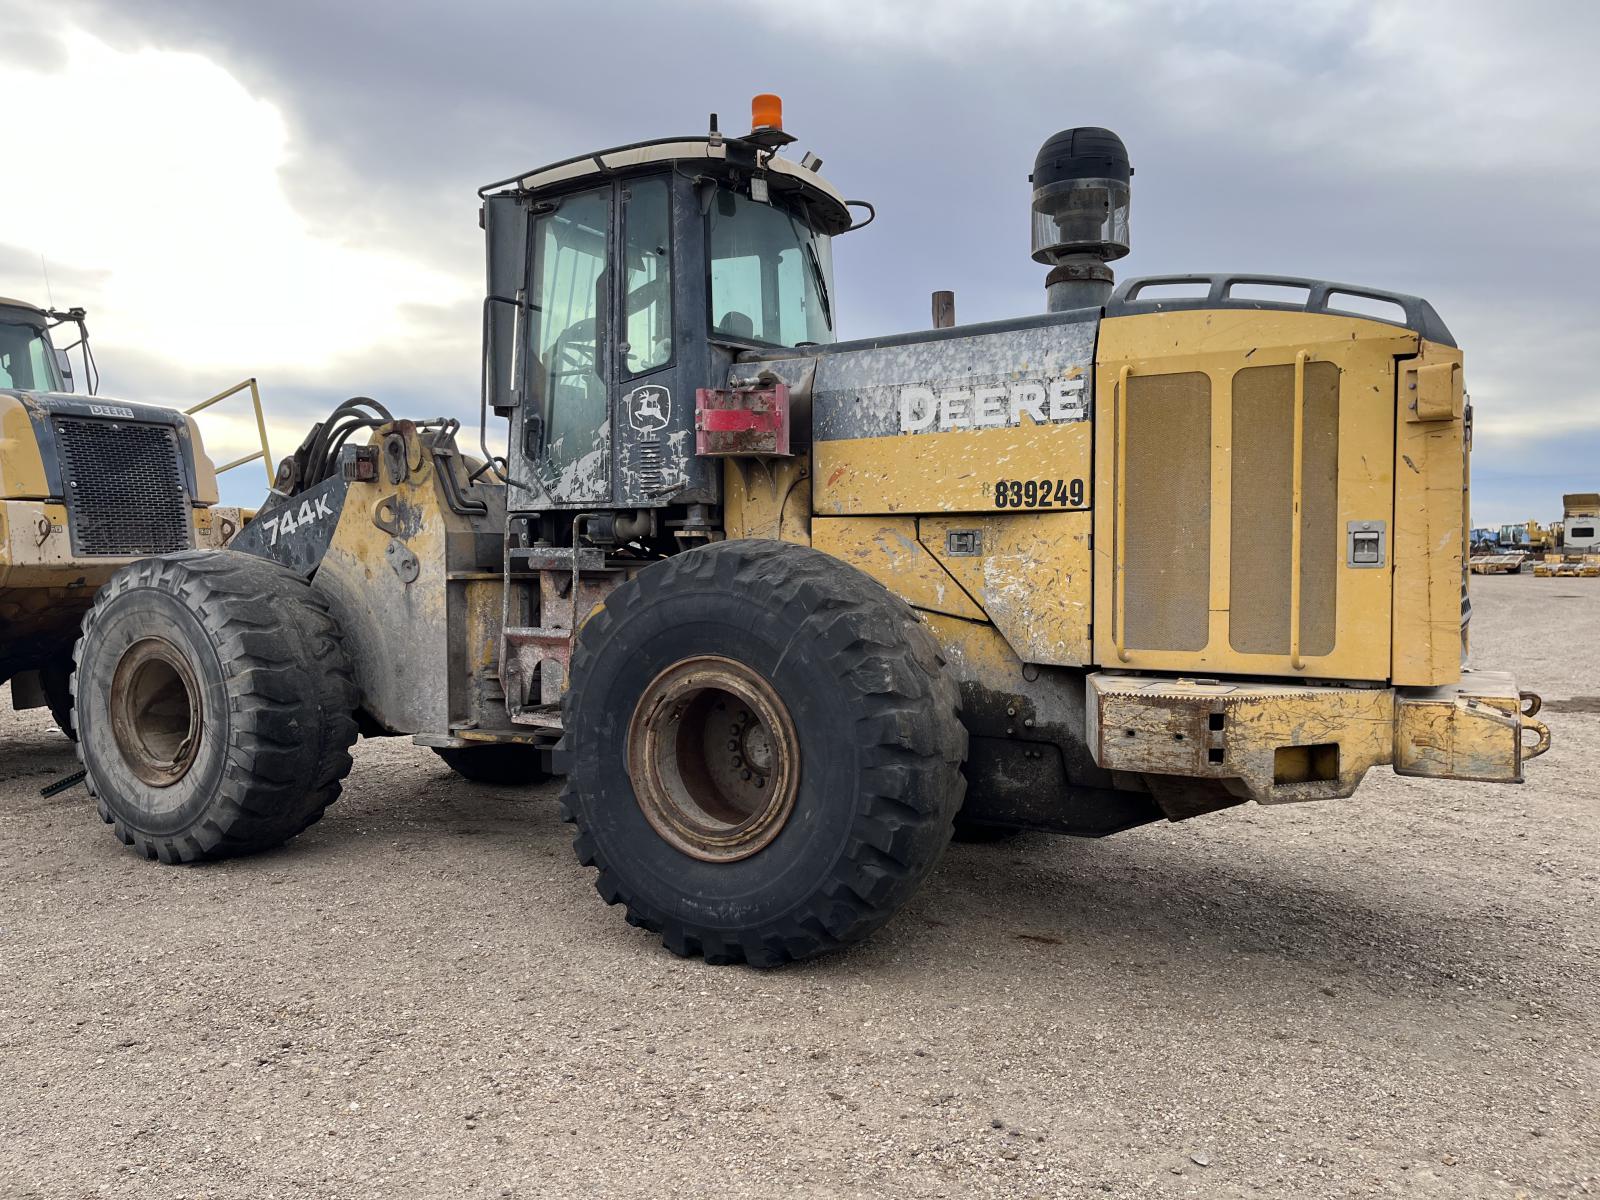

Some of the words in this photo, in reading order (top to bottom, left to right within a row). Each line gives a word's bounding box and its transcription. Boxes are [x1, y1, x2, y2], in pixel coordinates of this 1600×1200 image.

[91, 405, 134, 418] DEERE
[900, 379, 1084, 431] DEERE
[995, 479, 1084, 508] 839249
[262, 493, 333, 546] 744K
